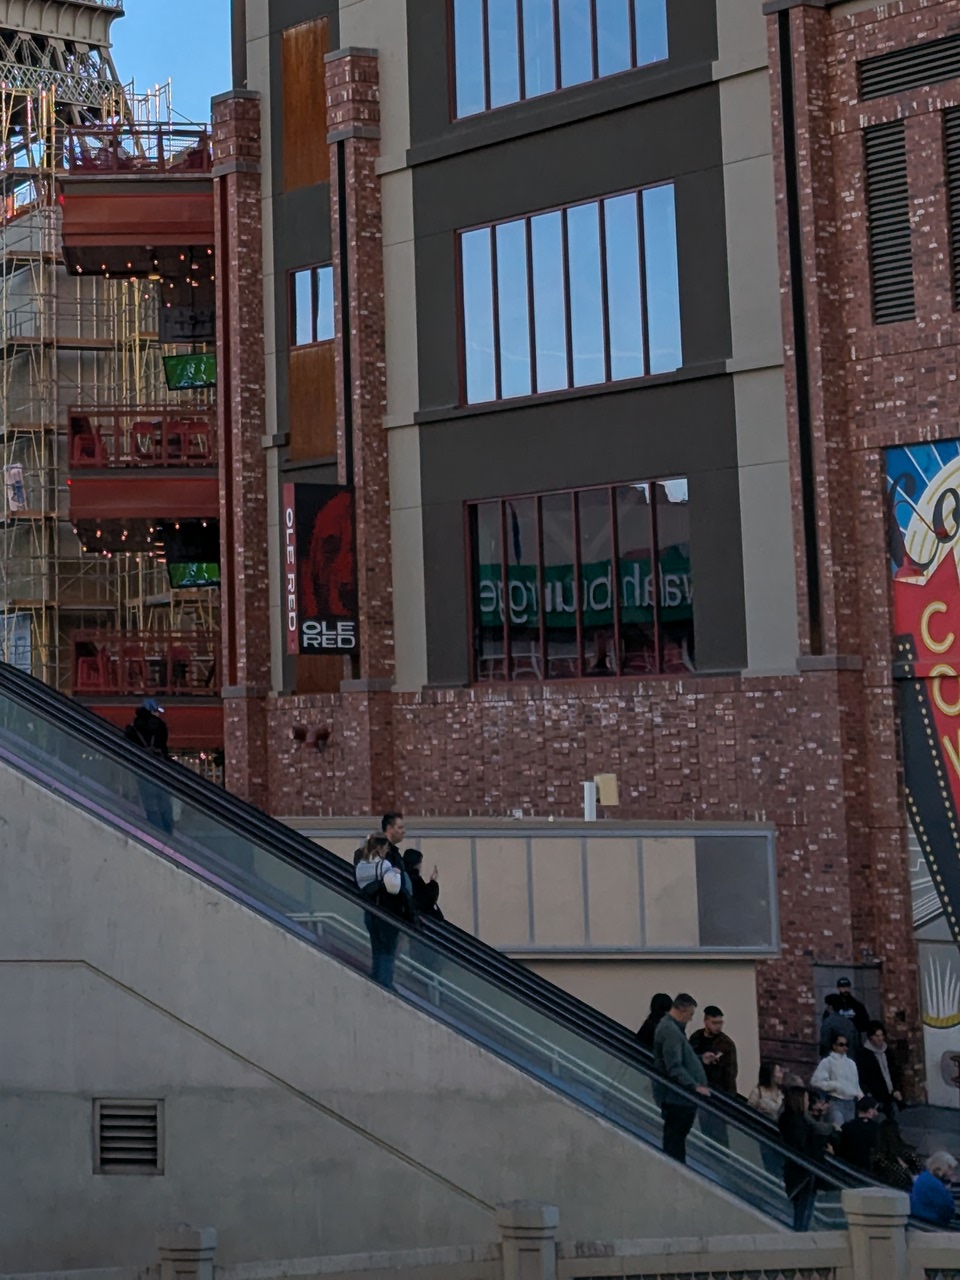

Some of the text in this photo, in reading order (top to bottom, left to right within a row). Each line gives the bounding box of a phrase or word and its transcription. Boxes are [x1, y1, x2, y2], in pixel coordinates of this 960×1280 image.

[285, 507, 297, 631] OLE RED
[302, 621, 355, 635] OLE
[303, 635, 356, 648] RED
